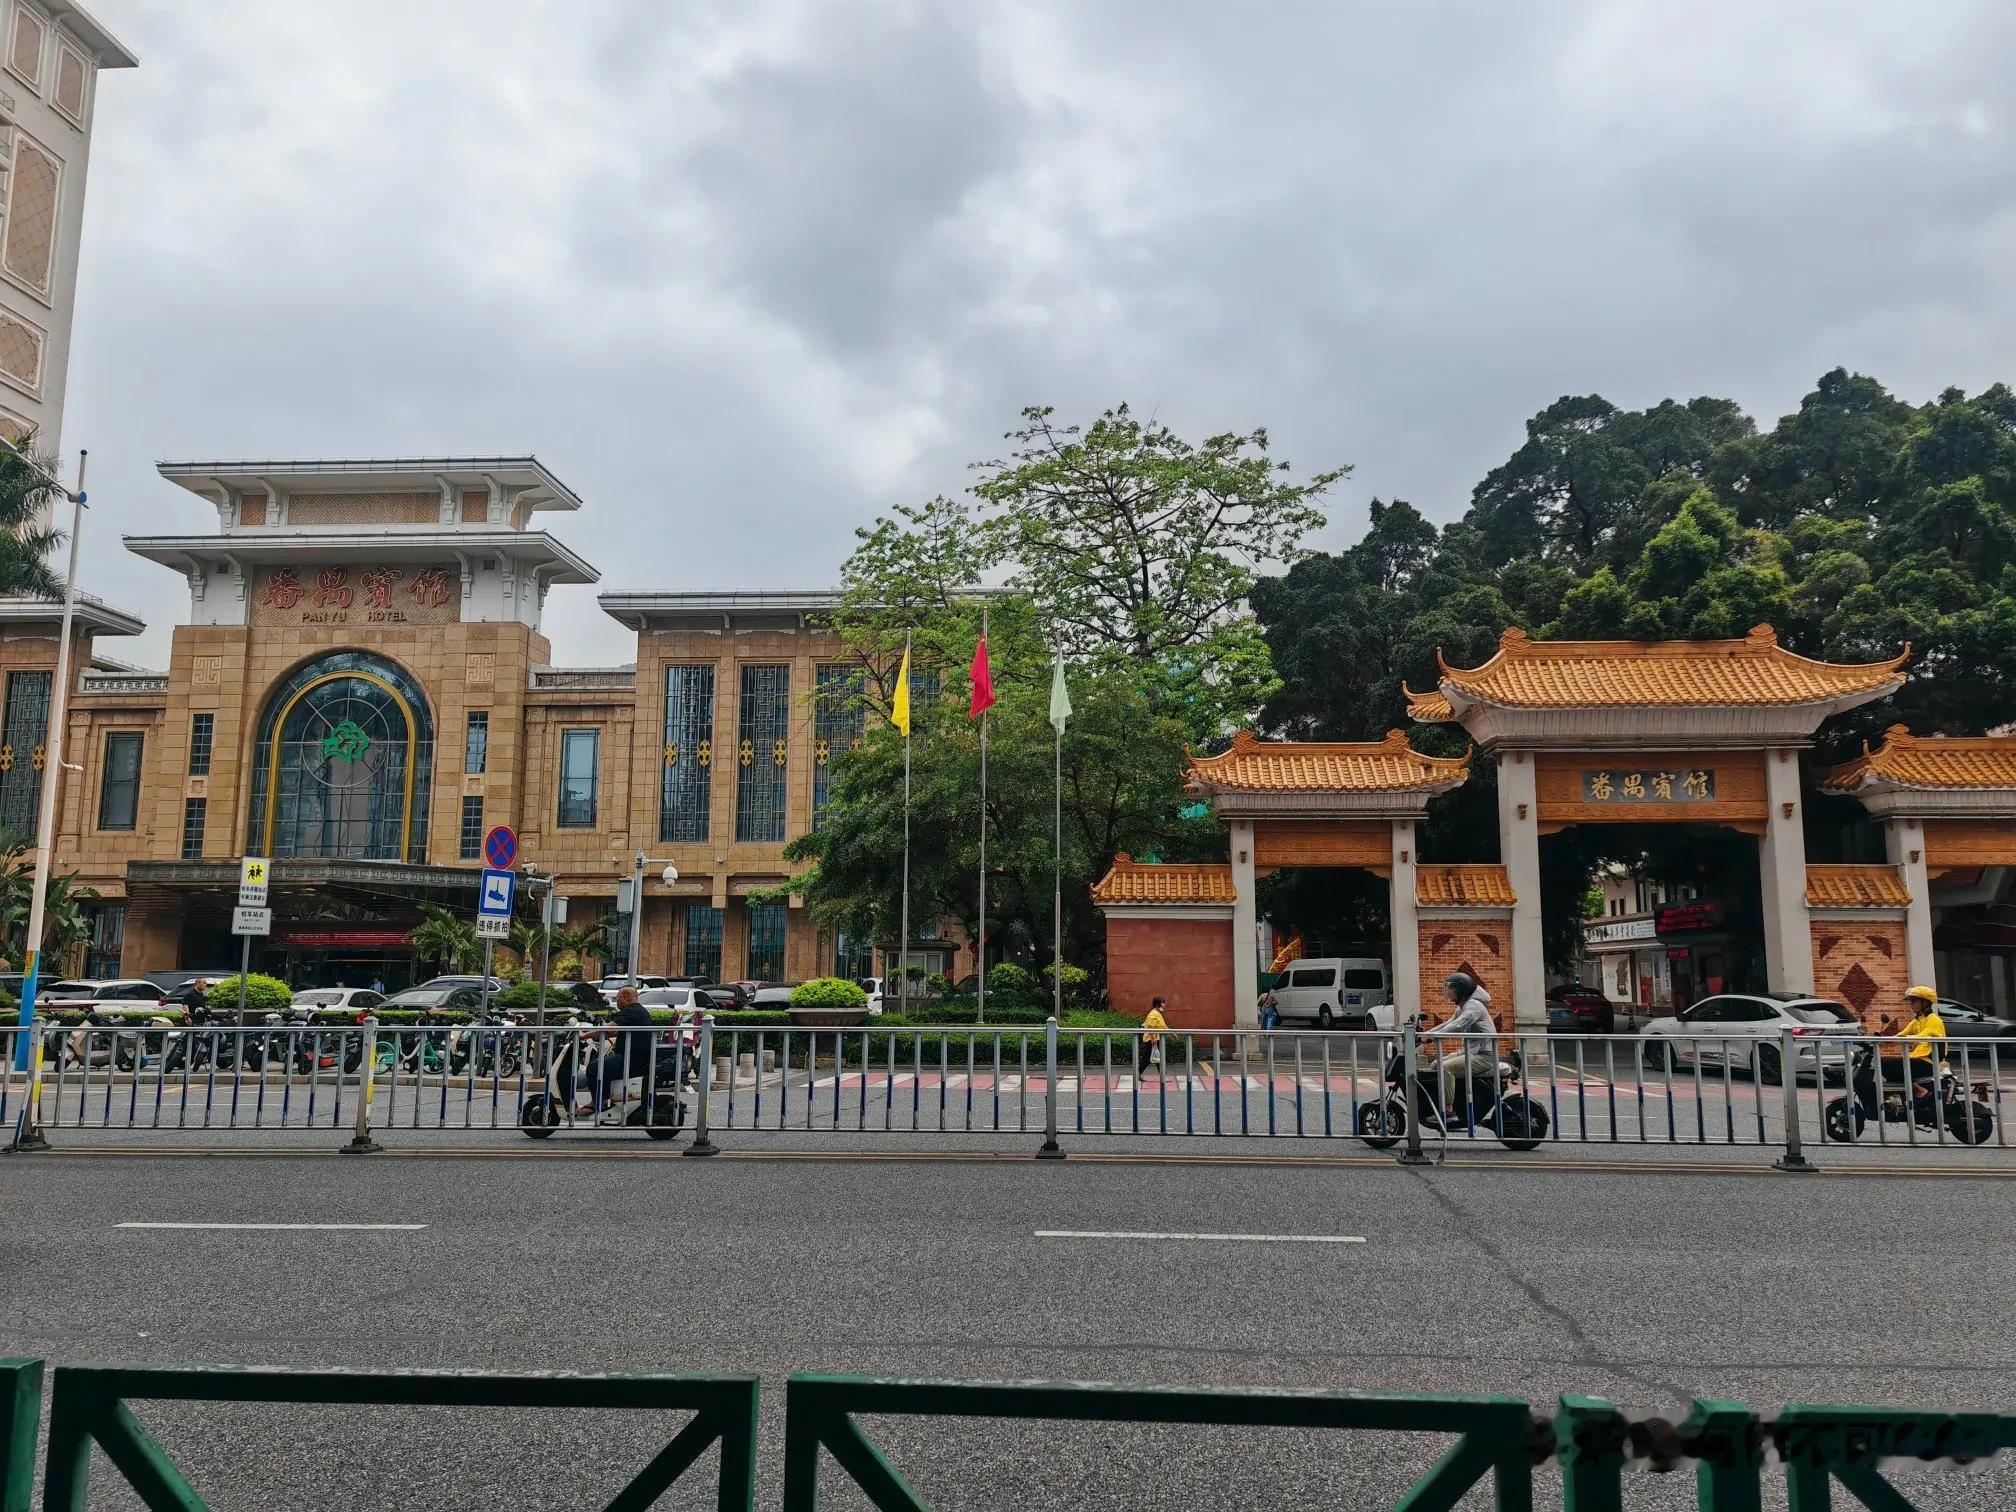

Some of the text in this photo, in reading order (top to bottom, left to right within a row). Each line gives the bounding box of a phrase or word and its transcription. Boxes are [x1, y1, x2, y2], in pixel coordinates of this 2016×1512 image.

[302, 611, 407, 623] PANYU HOTEL
[241, 910, 265, 918] 校车站点
[478, 920, 508, 933] 违停抓拍
